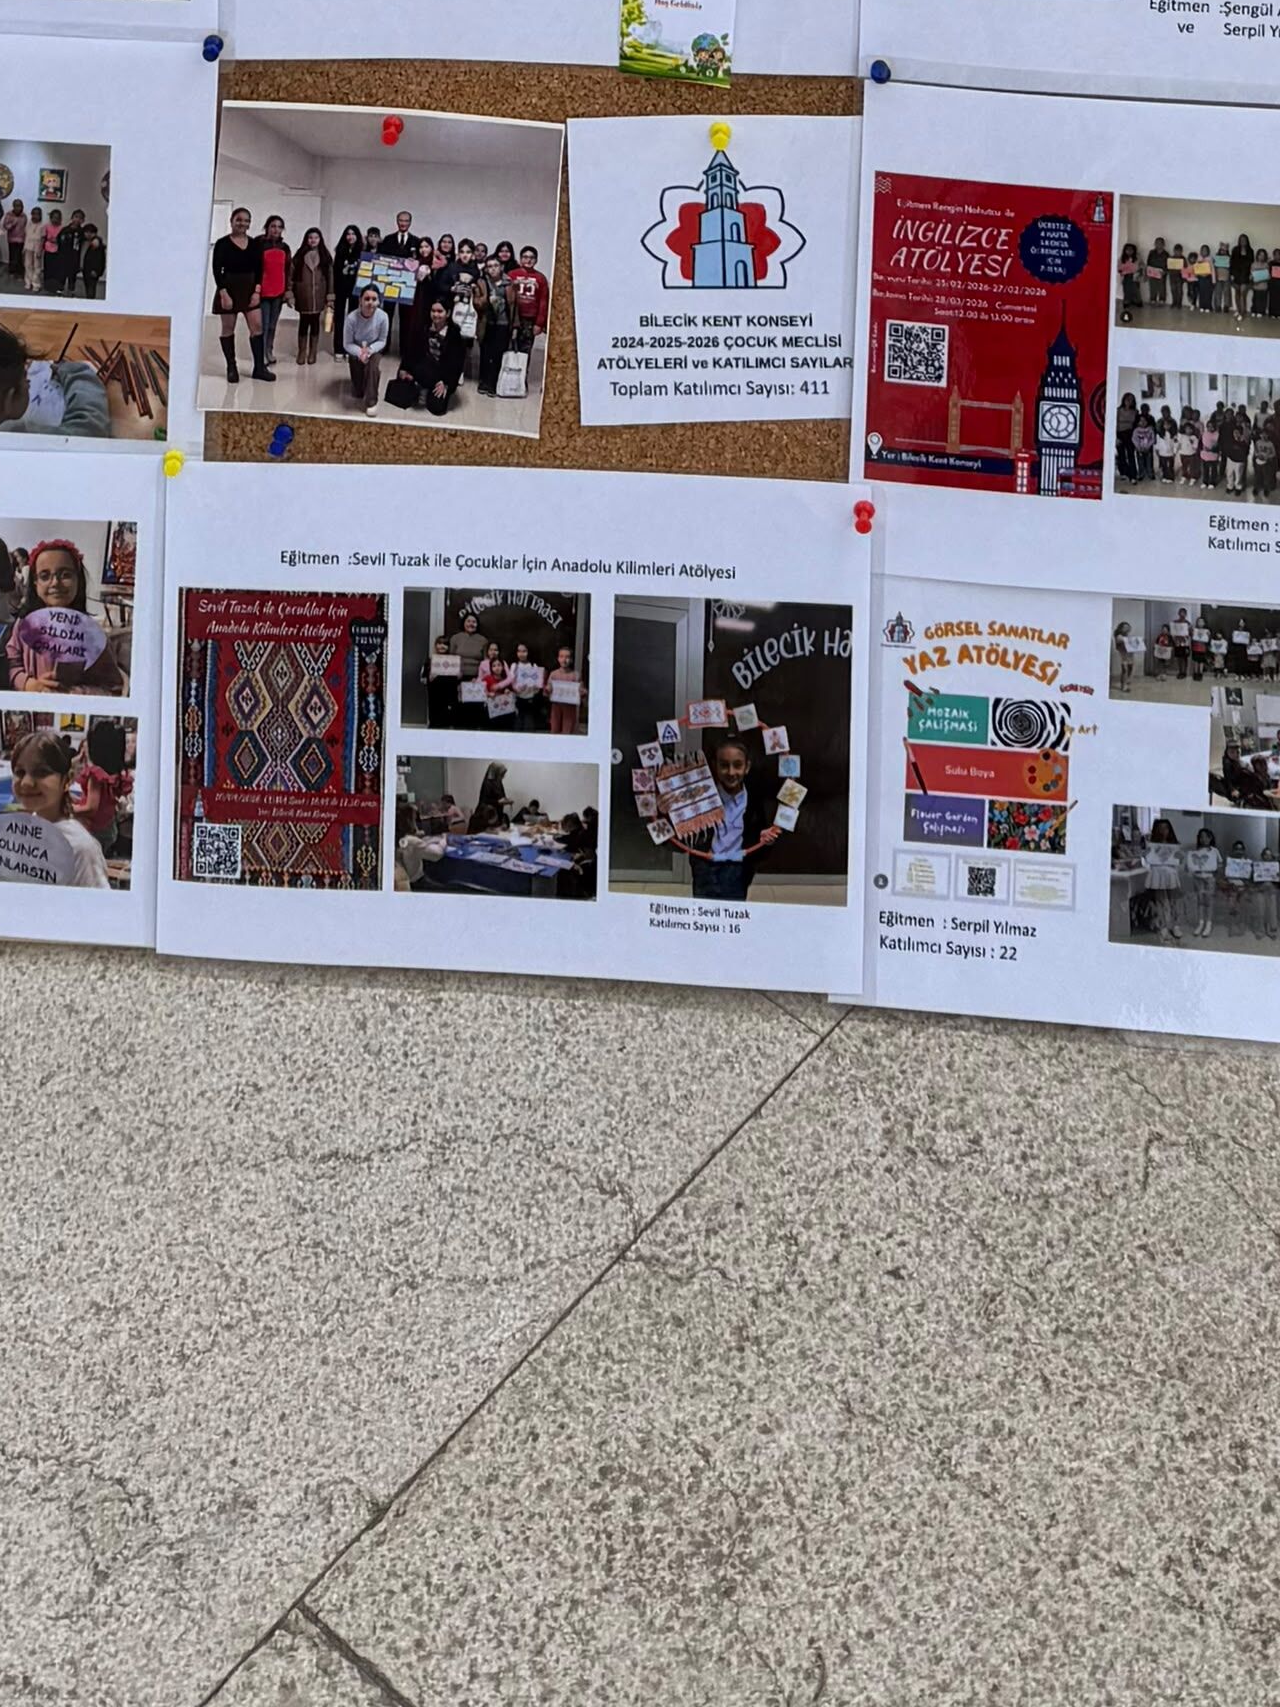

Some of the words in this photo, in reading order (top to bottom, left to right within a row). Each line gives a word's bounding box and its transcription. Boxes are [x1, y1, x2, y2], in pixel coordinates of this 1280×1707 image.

[1177, 22, 1194, 33] ve
[1224, 23, 1265, 38] Serpil
[932, 201, 963, 214] Rengin
[892, 215, 1013, 250] İNGİLİZCE
[890, 245, 1014, 277] ATÖLYESİ
[639, 313, 698, 327] BİLECİK
[702, 315, 742, 327] KENT
[746, 313, 813, 327] KONSEYİ
[612, 336, 719, 348] 2024-2025-2026
[724, 336, 778, 350] ÇOCUK
[781, 333, 842, 348] MECLİSİ
[597, 355, 687, 370] ATÖLYELERİ
[692, 359, 708, 369] ve
[712, 357, 786, 369] KATILIMCI
[610, 381, 668, 399] Toplam
[673, 380, 741, 396] Katılımcı
[746, 380, 795, 399] Sayısı:
[800, 380, 830, 395] 411
[1209, 515, 1269, 532] Eğitmen
[1208, 536, 1270, 553] Katılımcı
[280, 550, 339, 567] Eğitmen
[389, 553, 430, 567] Tuzak
[434, 554, 450, 567] ile
[455, 553, 518, 571] Çocuklar
[522, 554, 547, 573] İçin
[551, 557, 611, 574] Anadolu
[616, 561, 674, 576] Kilimleri
[679, 564, 736, 582] Atölyesi
[278, 602, 325, 619] Çocuklar
[206, 620, 249, 634] Anadolu
[924, 621, 983, 640] GÖRSEL
[988, 621, 1070, 650] SANATLAR
[903, 646, 950, 675] YAZ
[957, 643, 1062, 686] ATÖLYESİ
[927, 707, 969, 719] MOZAİK
[1078, 723, 1098, 735] Art
[945, 765, 967, 777] Sulu
[970, 767, 995, 779] Boya
[911, 808, 942, 821] Flower
[945, 808, 978, 824] Garden
[6, 822, 42, 839] ANNE
[0, 838, 49, 862] OLUNCA
[650, 902, 689, 915] Eğitmen
[698, 907, 720, 917] Sevil
[724, 909, 750, 919] Tuzak
[649, 918, 690, 930] Katılımcı
[729, 924, 741, 934] 16
[879, 910, 934, 929] Eğitmen
[951, 917, 990, 935] Serpil
[994, 921, 1037, 938] Yılmaz
[879, 935, 941, 954] Katılımcı
[946, 941, 986, 960] Sayısı
[1000, 946, 1017, 961] 22
